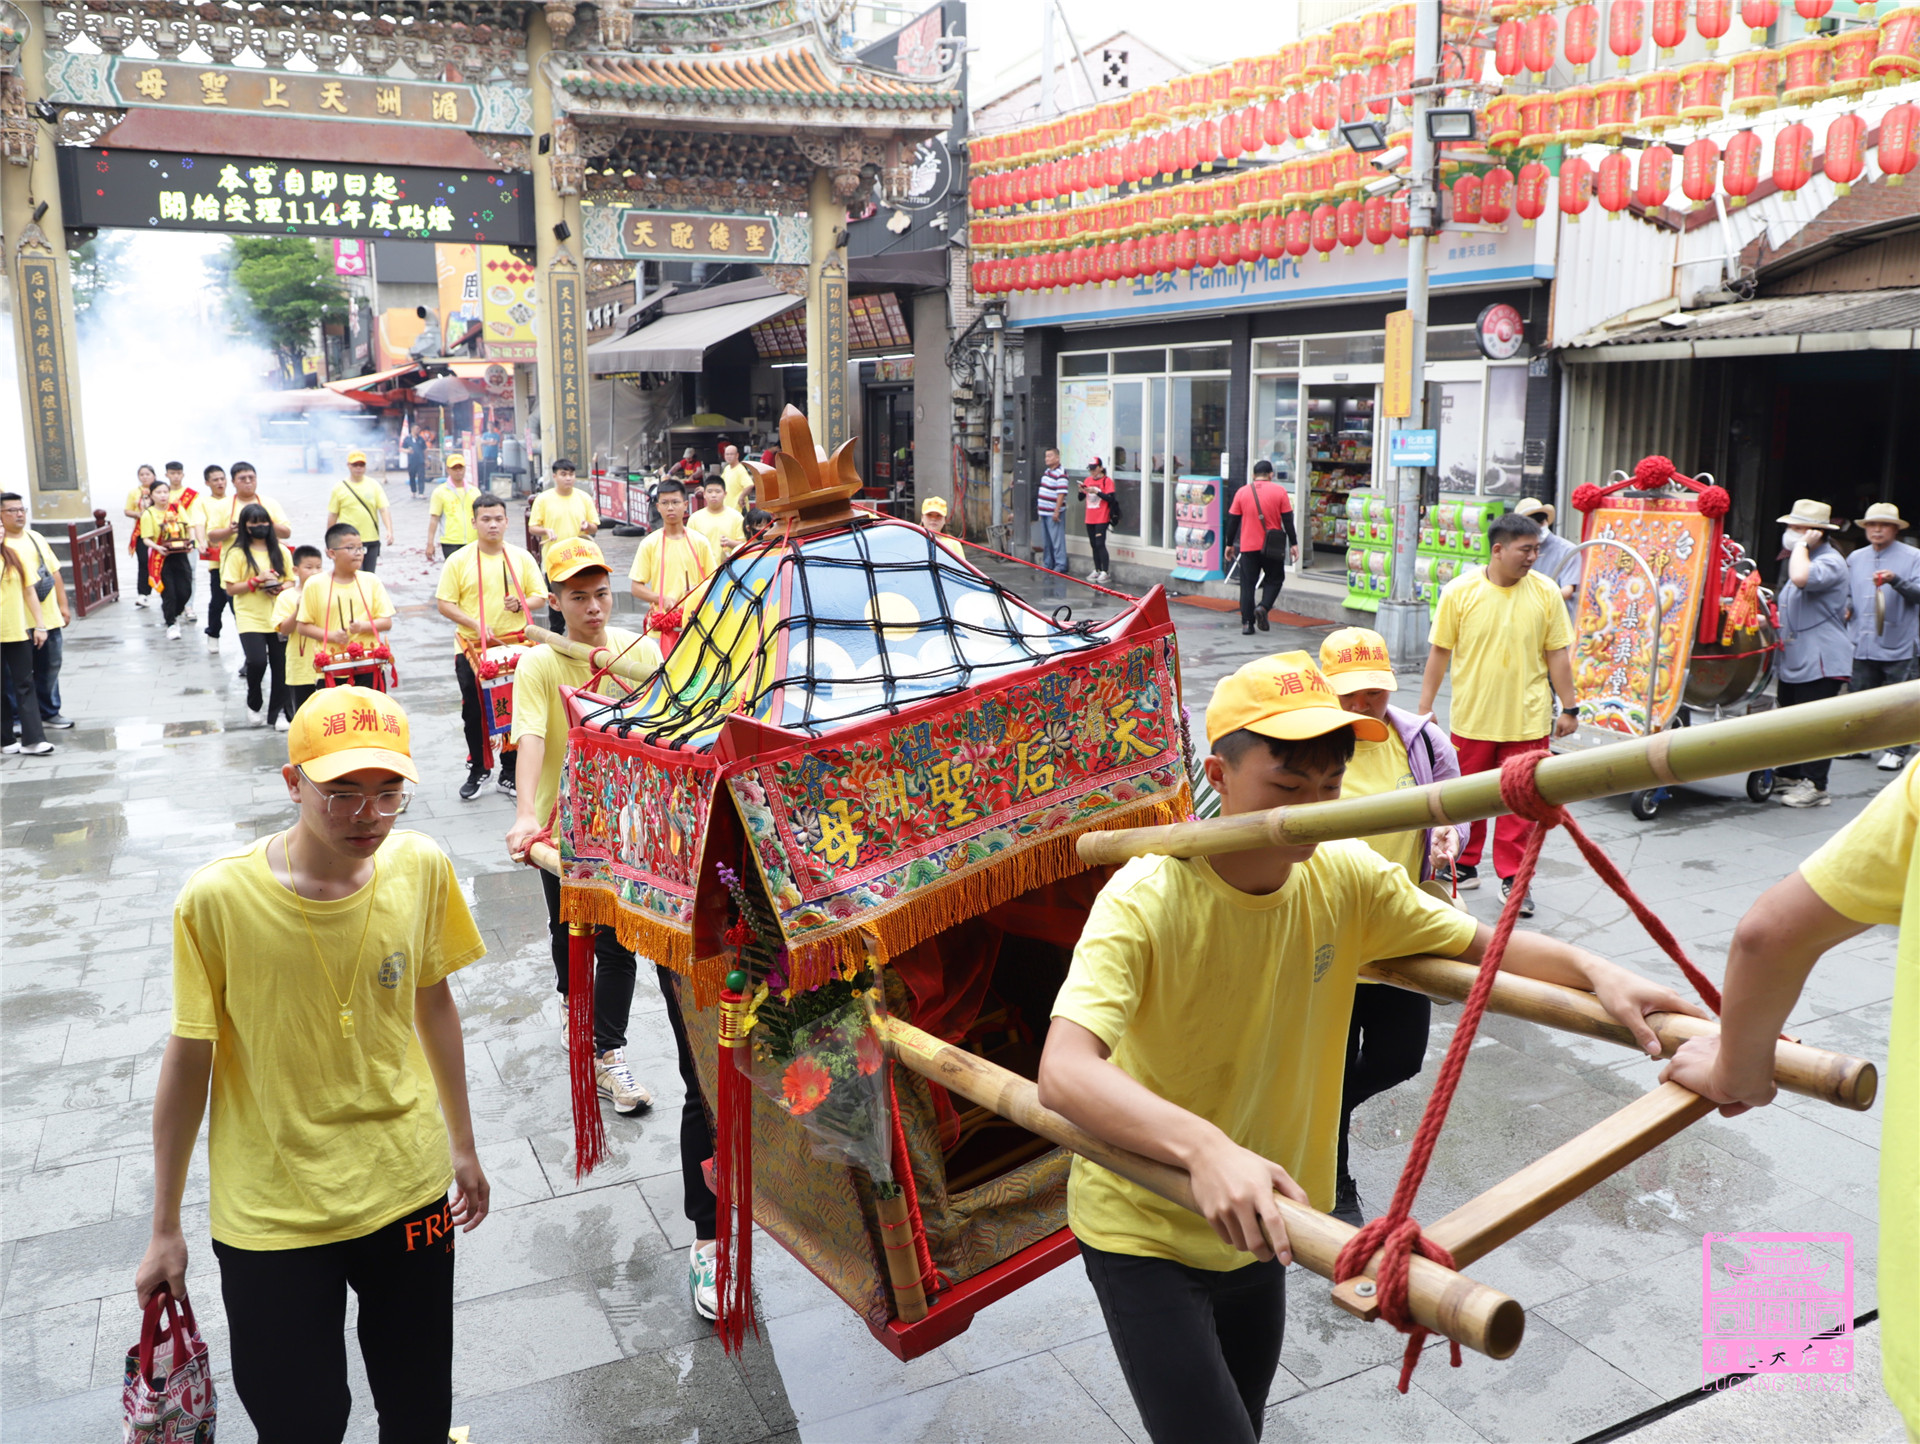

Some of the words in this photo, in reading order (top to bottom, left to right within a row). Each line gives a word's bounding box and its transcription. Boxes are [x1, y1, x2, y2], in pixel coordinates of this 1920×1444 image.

[217, 164, 400, 200] 本宮自即日起
[159, 191, 455, 231] 開始受理114年度點燈
[1337, 646, 1384, 664] 湄洲媽
[1608, 601, 1639, 696] 集英堂
[1273, 669, 1336, 696] 湄洲
[322, 708, 401, 737] 湄洲媽
